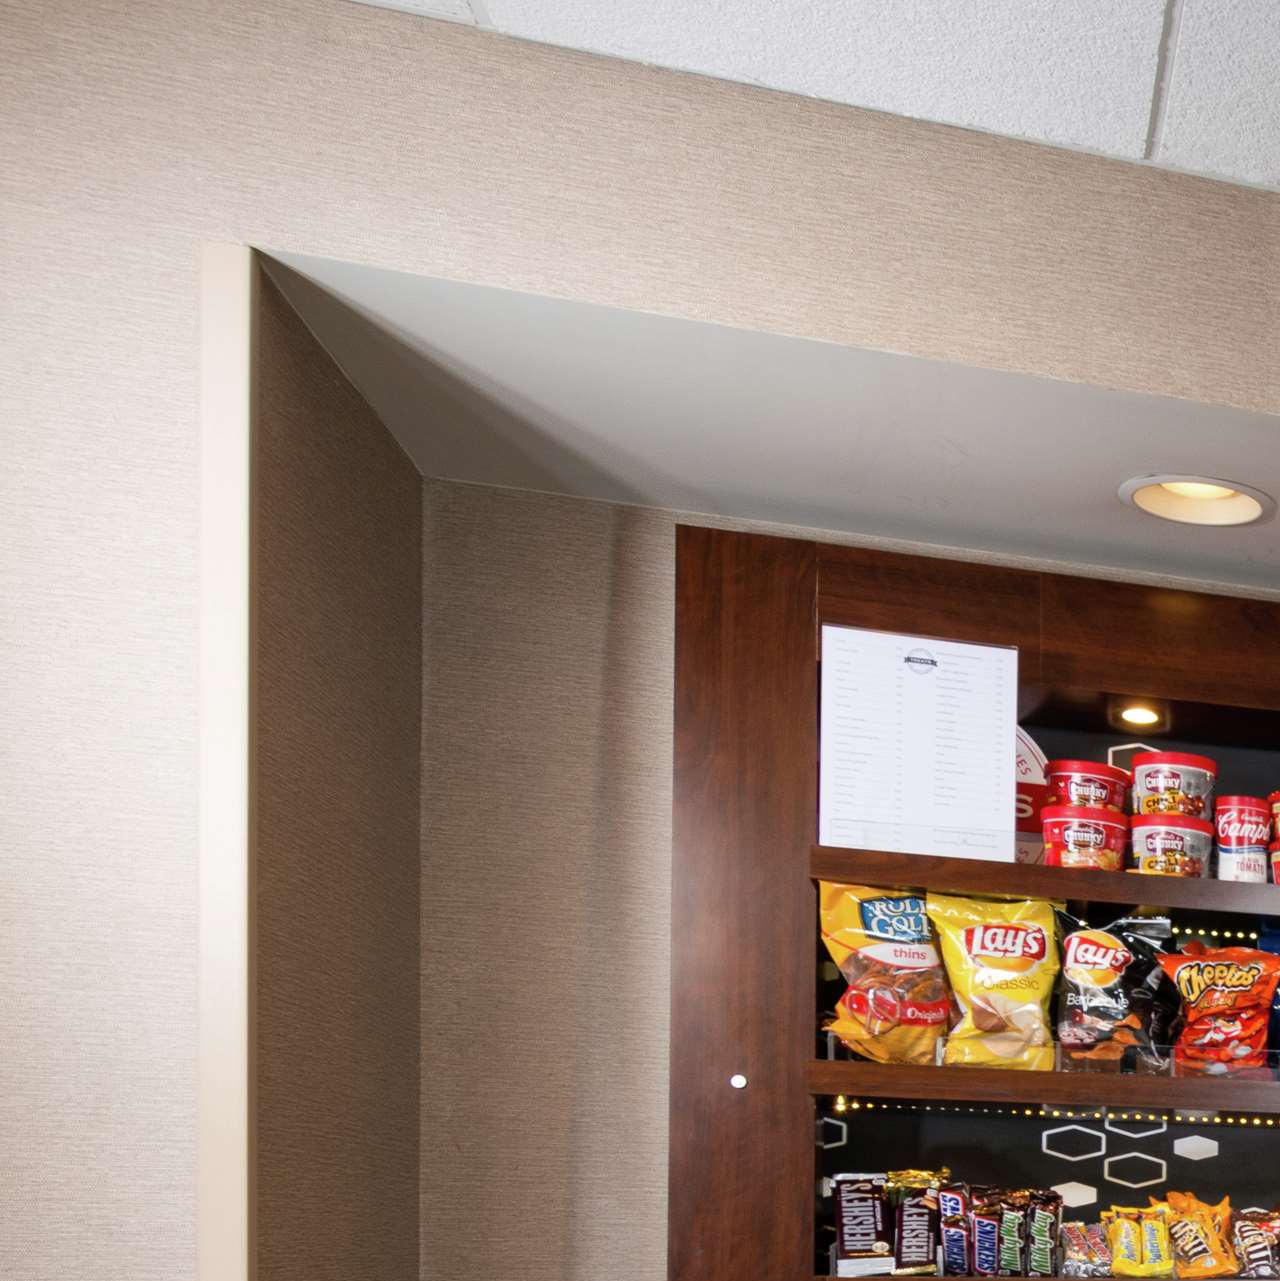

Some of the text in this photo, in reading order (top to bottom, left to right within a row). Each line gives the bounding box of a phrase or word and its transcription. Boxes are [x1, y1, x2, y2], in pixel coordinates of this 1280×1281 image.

[893, 947, 927, 960] thins
[971, 923, 1044, 958] Lay's
[1065, 934, 1132, 970] Lay's
[1066, 991, 1129, 1010] Barbue
[1177, 962, 1262, 1004] Cheetos
[907, 1008, 945, 1023] Original
[840, 1181, 877, 1251] HERSHEY'S
[900, 1196, 930, 1263] HERSHEY'S
[944, 1229, 969, 1274] SNICKERS
[976, 1218, 998, 1274] SNICKERS
